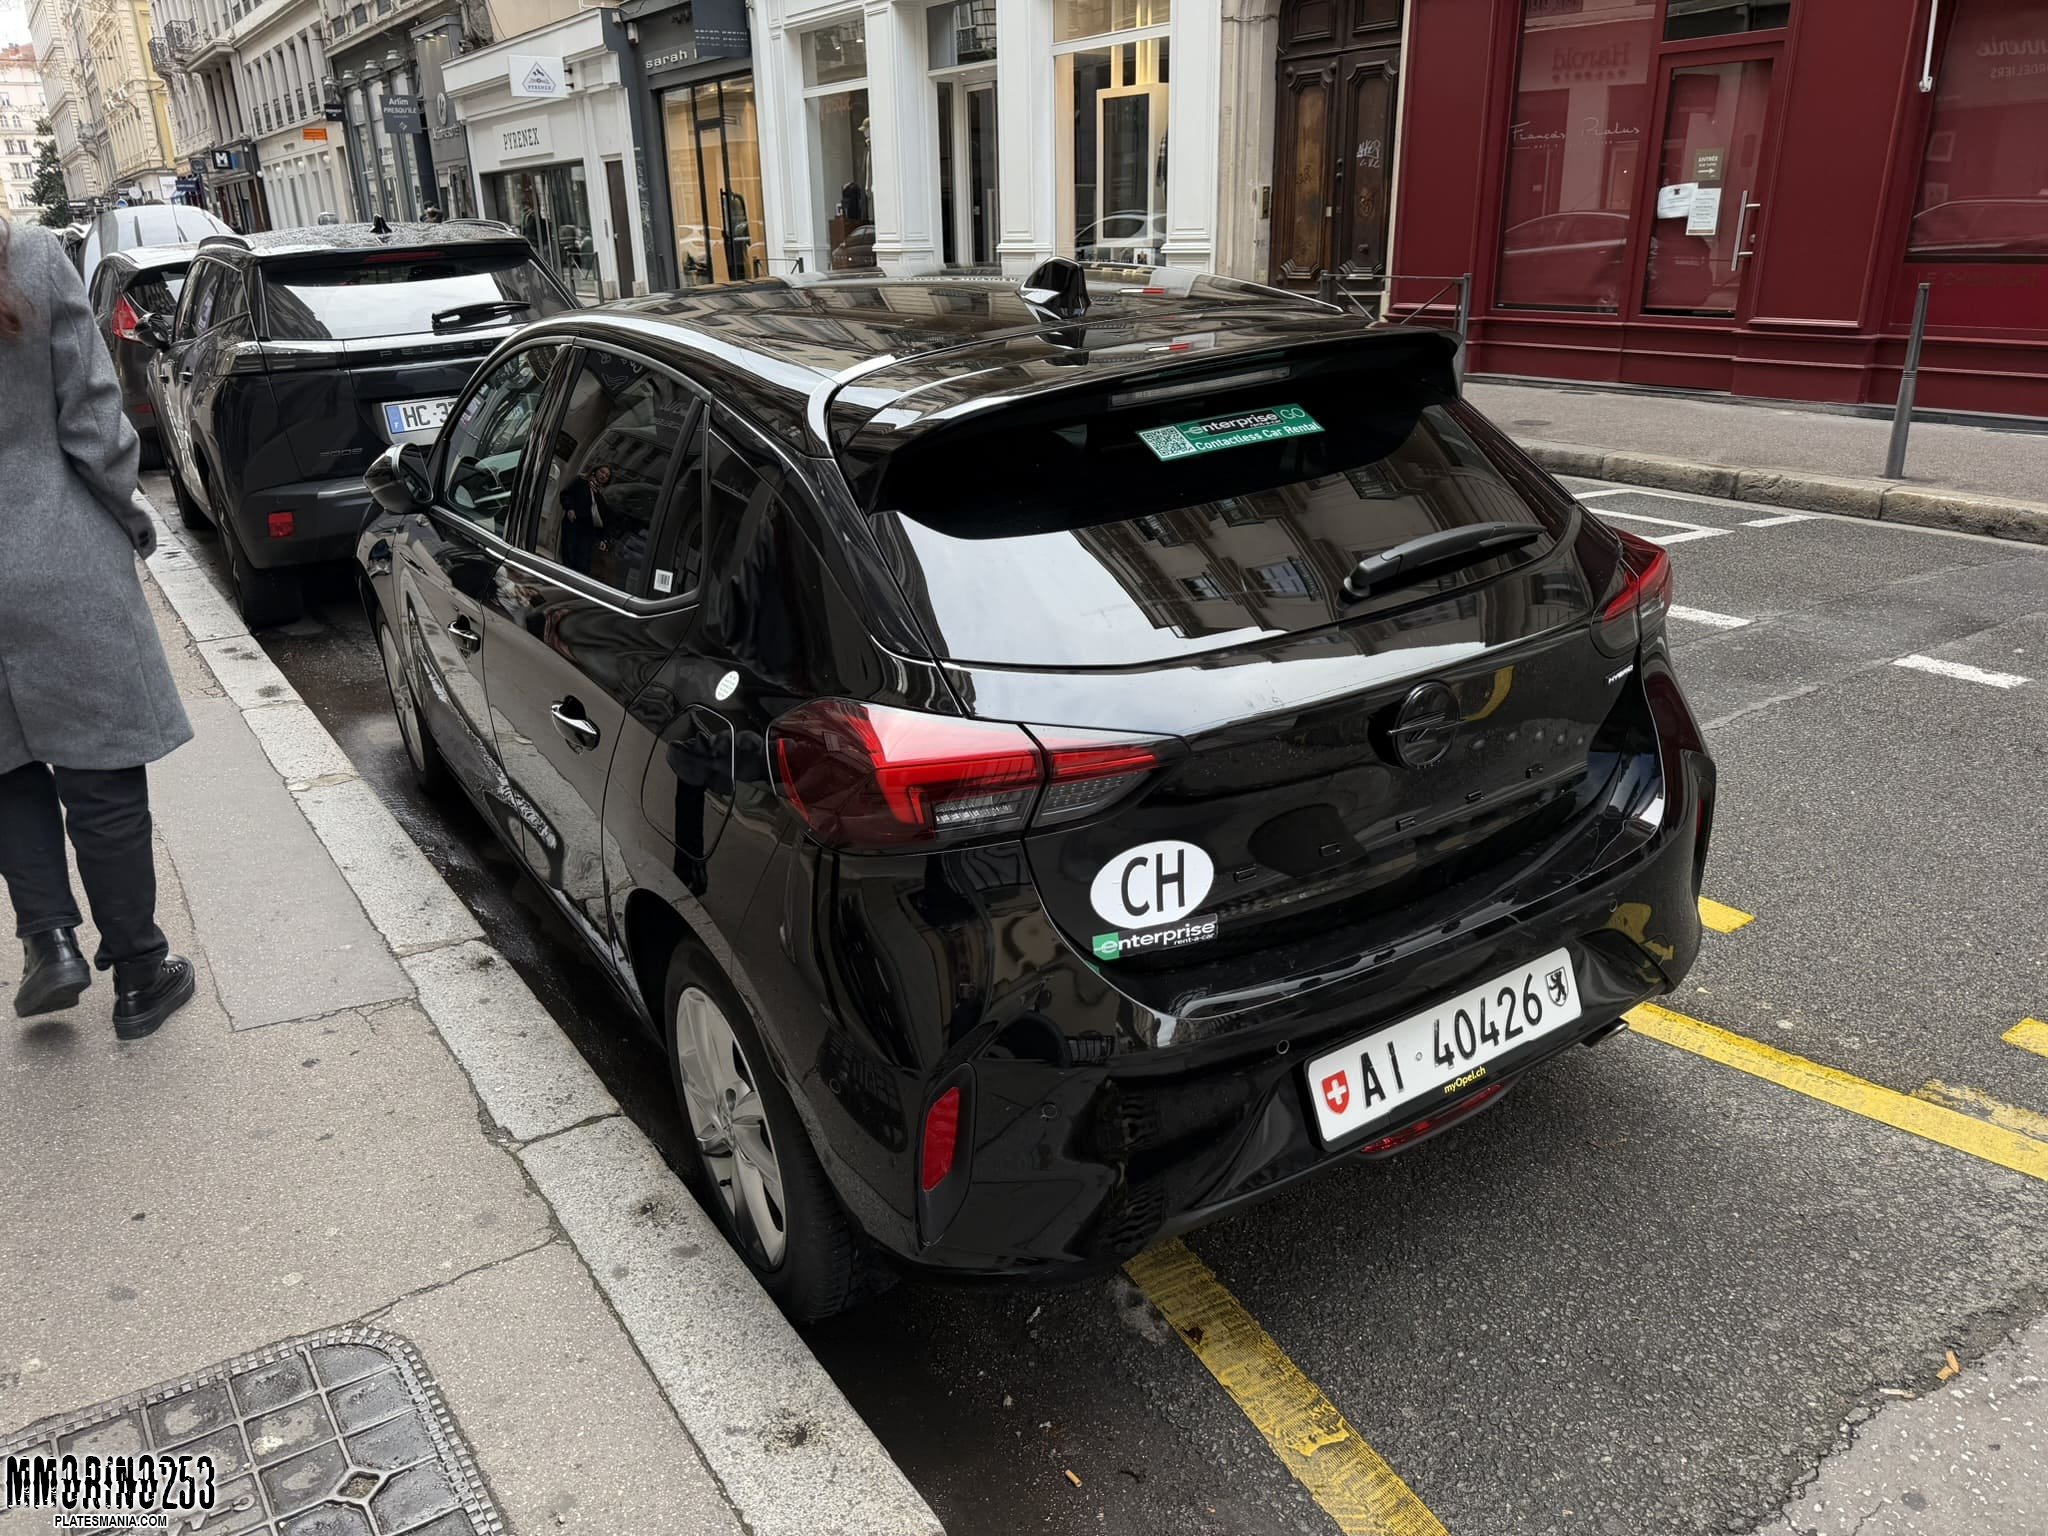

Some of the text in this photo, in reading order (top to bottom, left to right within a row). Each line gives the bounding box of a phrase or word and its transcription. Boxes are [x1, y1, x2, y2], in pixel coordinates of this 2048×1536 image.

[645, 50, 688, 69] sarah
[503, 127, 540, 151] PYRENEX
[379, 340, 494, 358] PEUGEO
[1183, 407, 1306, 434] enterprise GO
[1195, 421, 1321, 451] Contactless Car Rental
[1121, 848, 1185, 917] CH
[1094, 922, 1216, 954] enterprise
[1433, 973, 1543, 1069] 40426
[1444, 1065, 1487, 1094] myOpel.ch
